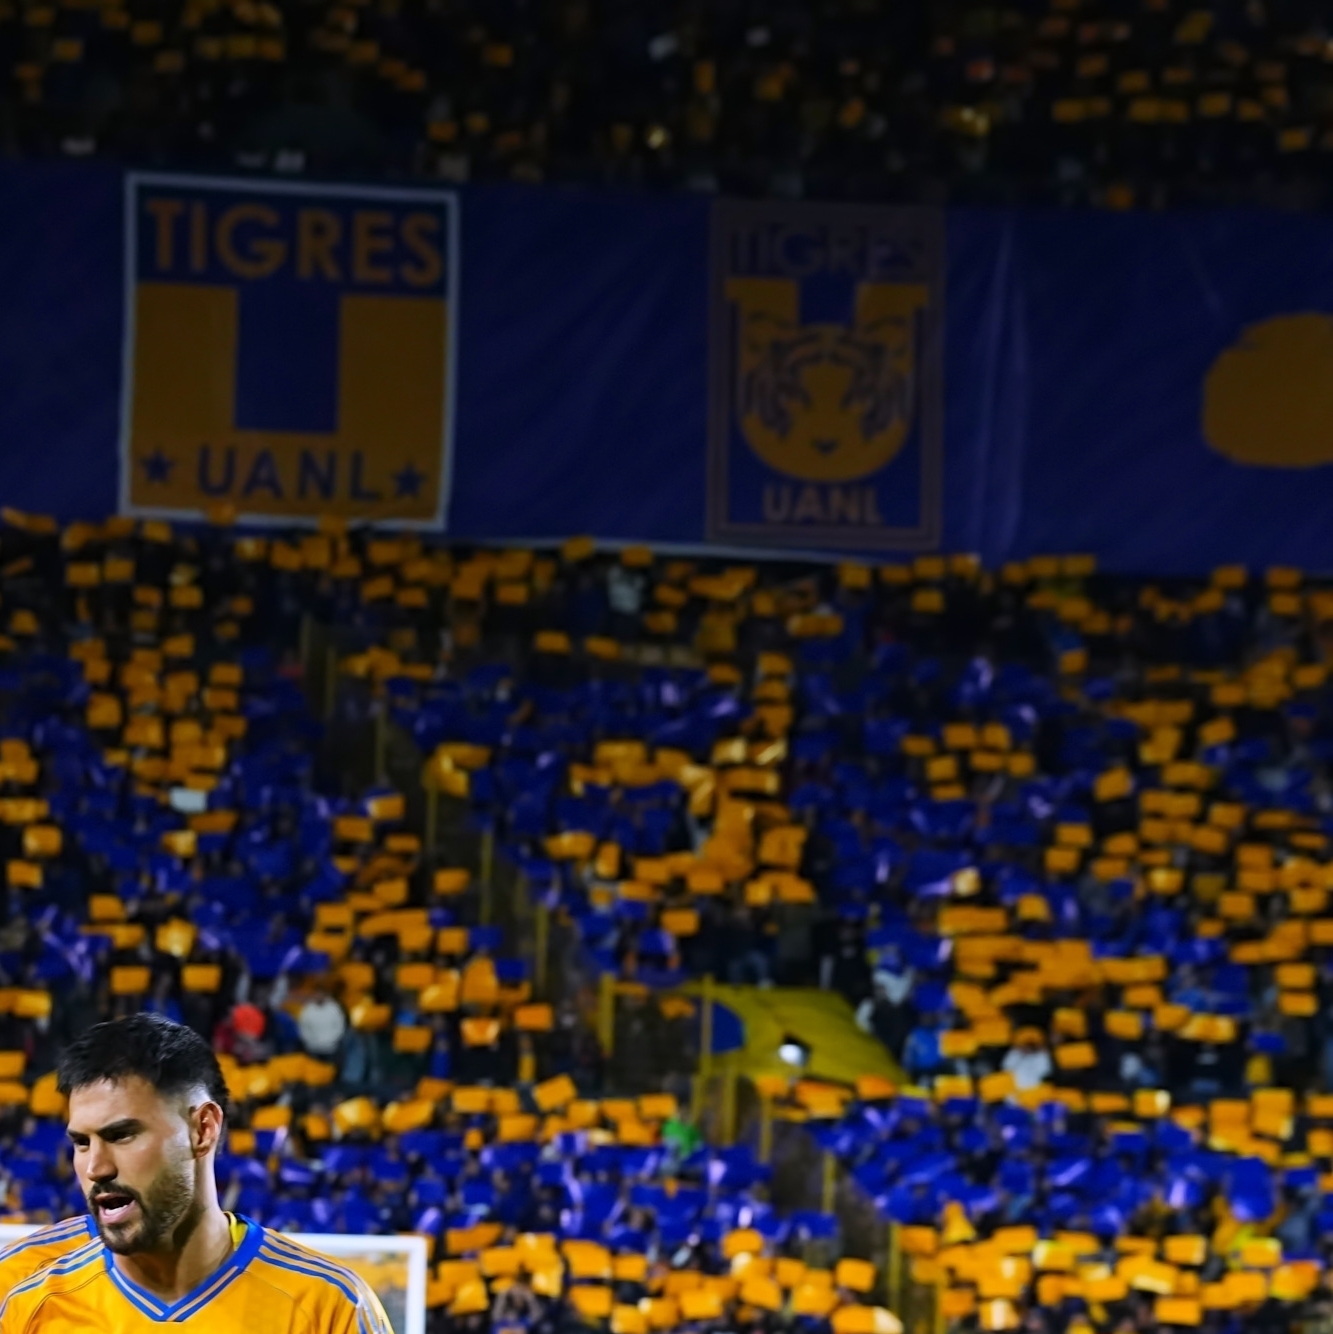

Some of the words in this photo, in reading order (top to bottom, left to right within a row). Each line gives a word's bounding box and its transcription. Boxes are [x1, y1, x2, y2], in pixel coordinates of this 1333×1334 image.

[145, 198, 445, 287] TIGRES
[197, 446, 383, 502] UANL
[762, 484, 884, 524] UANL
